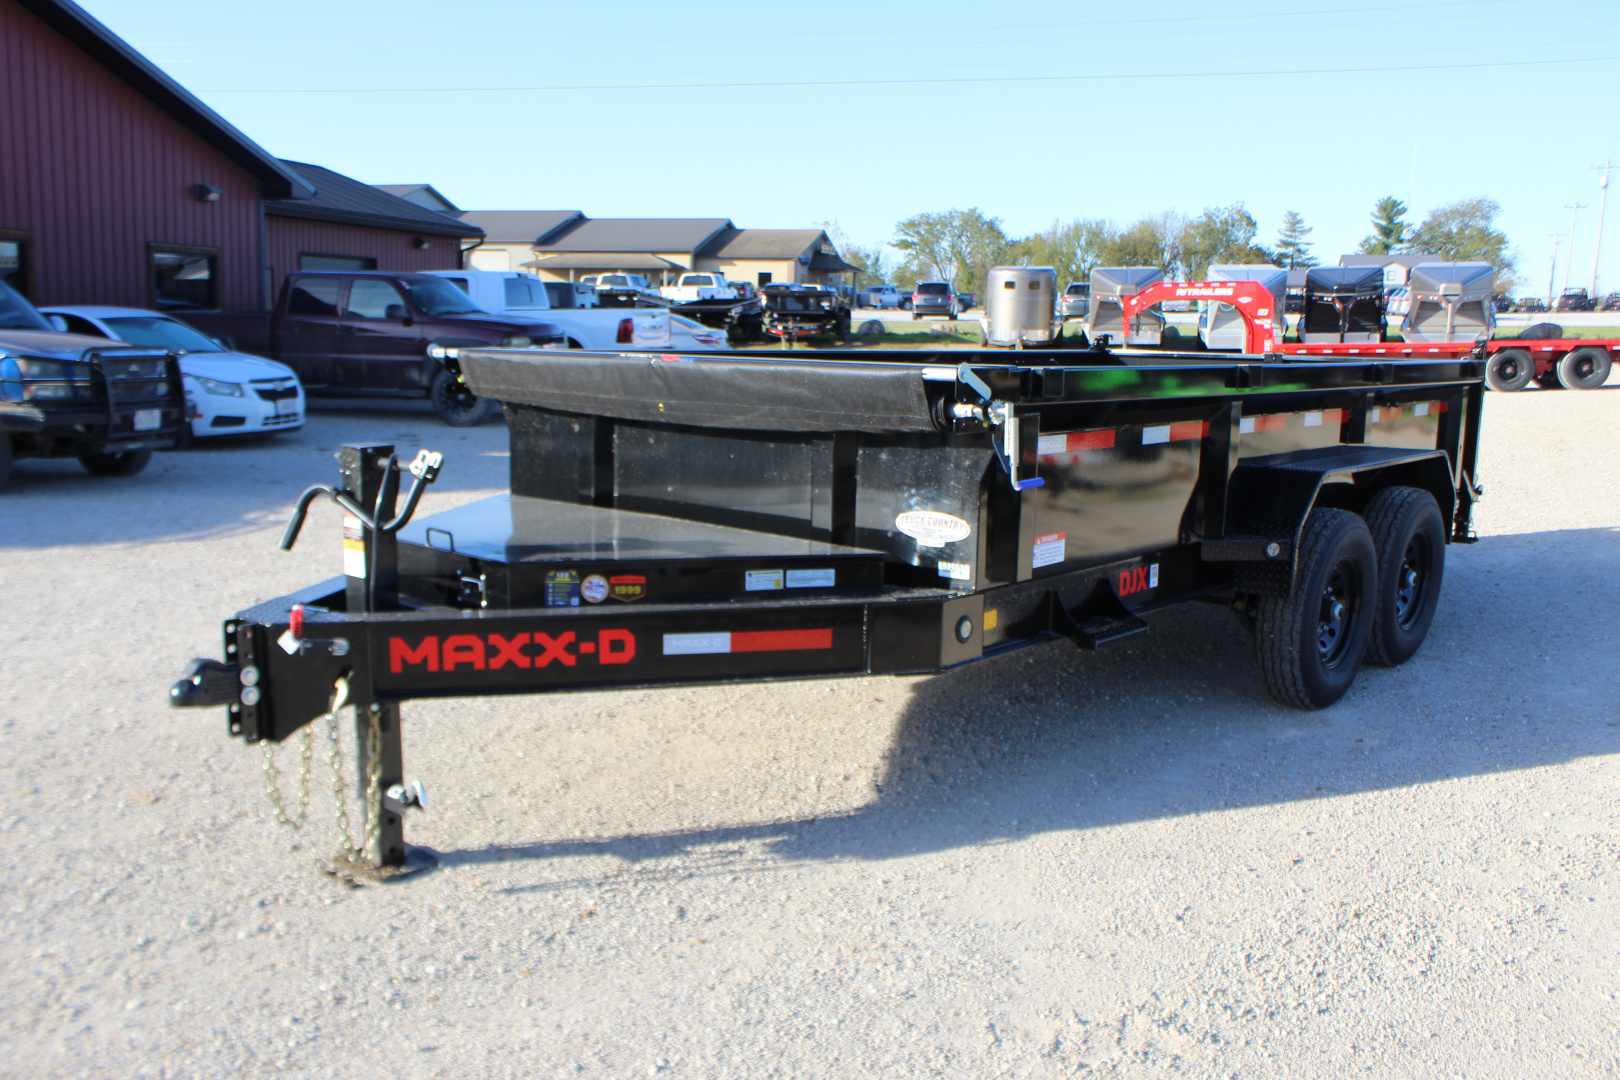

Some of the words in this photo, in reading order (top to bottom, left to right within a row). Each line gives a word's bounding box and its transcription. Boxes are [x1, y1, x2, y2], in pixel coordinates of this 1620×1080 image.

[1187, 288, 1233, 297] TRAILERS
[901, 515, 925, 524] TRUCK
[927, 517, 964, 530] COUNTRY
[1041, 534, 1058, 543] DANGER
[1119, 565, 1149, 597] DJX
[614, 585, 642, 595] 1999
[672, 638, 722, 649] MAXX-D
[388, 628, 636, 674] MAXX-D
